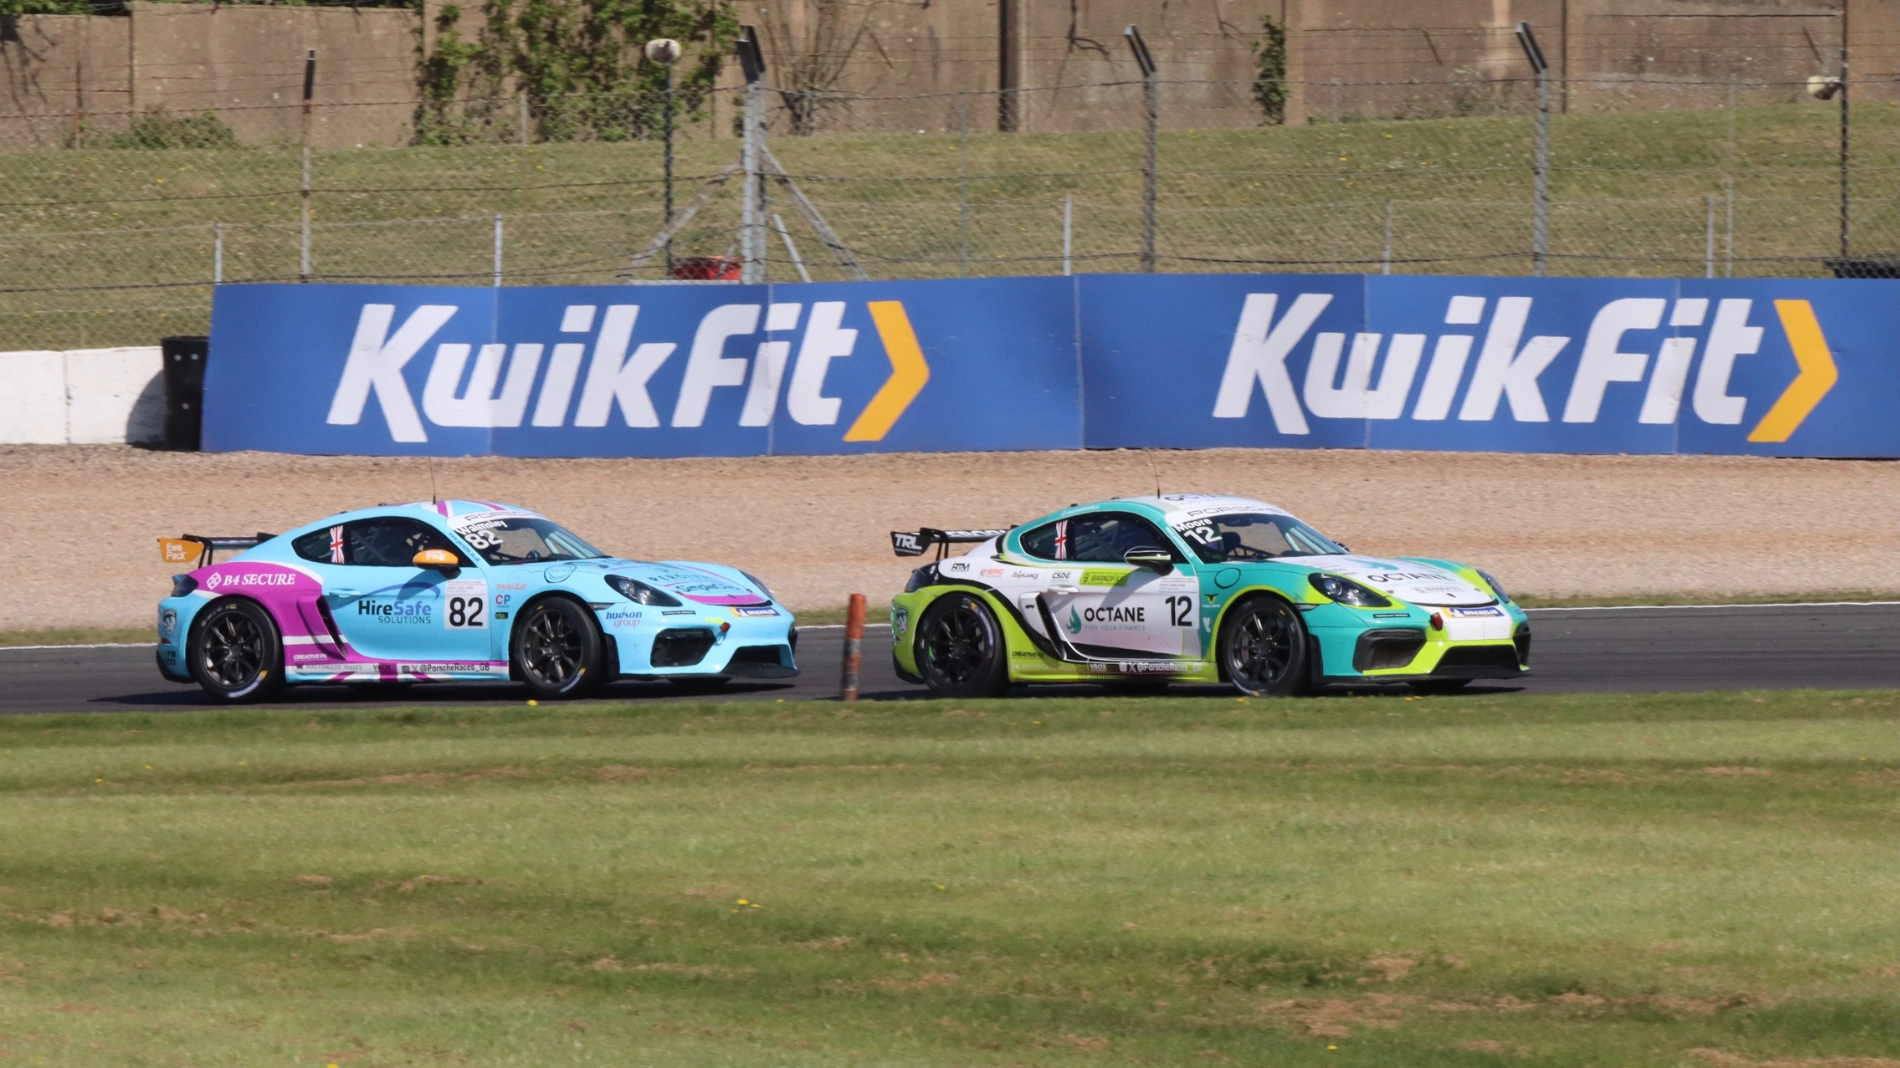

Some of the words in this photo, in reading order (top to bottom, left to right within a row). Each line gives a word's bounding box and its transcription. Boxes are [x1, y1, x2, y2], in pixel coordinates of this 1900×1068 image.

[328, 301, 677, 442] Kwik
[1213, 293, 1570, 435] Kwik
[455, 519, 508, 535] Walmsley
[1172, 518, 1213, 533] Moore
[464, 530, 504, 550] 82
[894, 533, 923, 551] TRL
[1183, 526, 1222, 545] 12
[166, 543, 183, 551] Ewe
[166, 551, 187, 560] Pack
[223, 576, 240, 586] B4
[241, 574, 296, 585] SECURE
[495, 594, 511, 606] CP
[358, 600, 432, 616] HireSafe
[449, 597, 483, 627] 82
[606, 607, 642, 620] hudson
[1084, 607, 1145, 622] OCTANE
[1165, 596, 1193, 627] 12
[378, 616, 432, 624] SOLUTIONS
[614, 619, 640, 629] group
[419, 664, 490, 673] @PorscheRaces_GB
